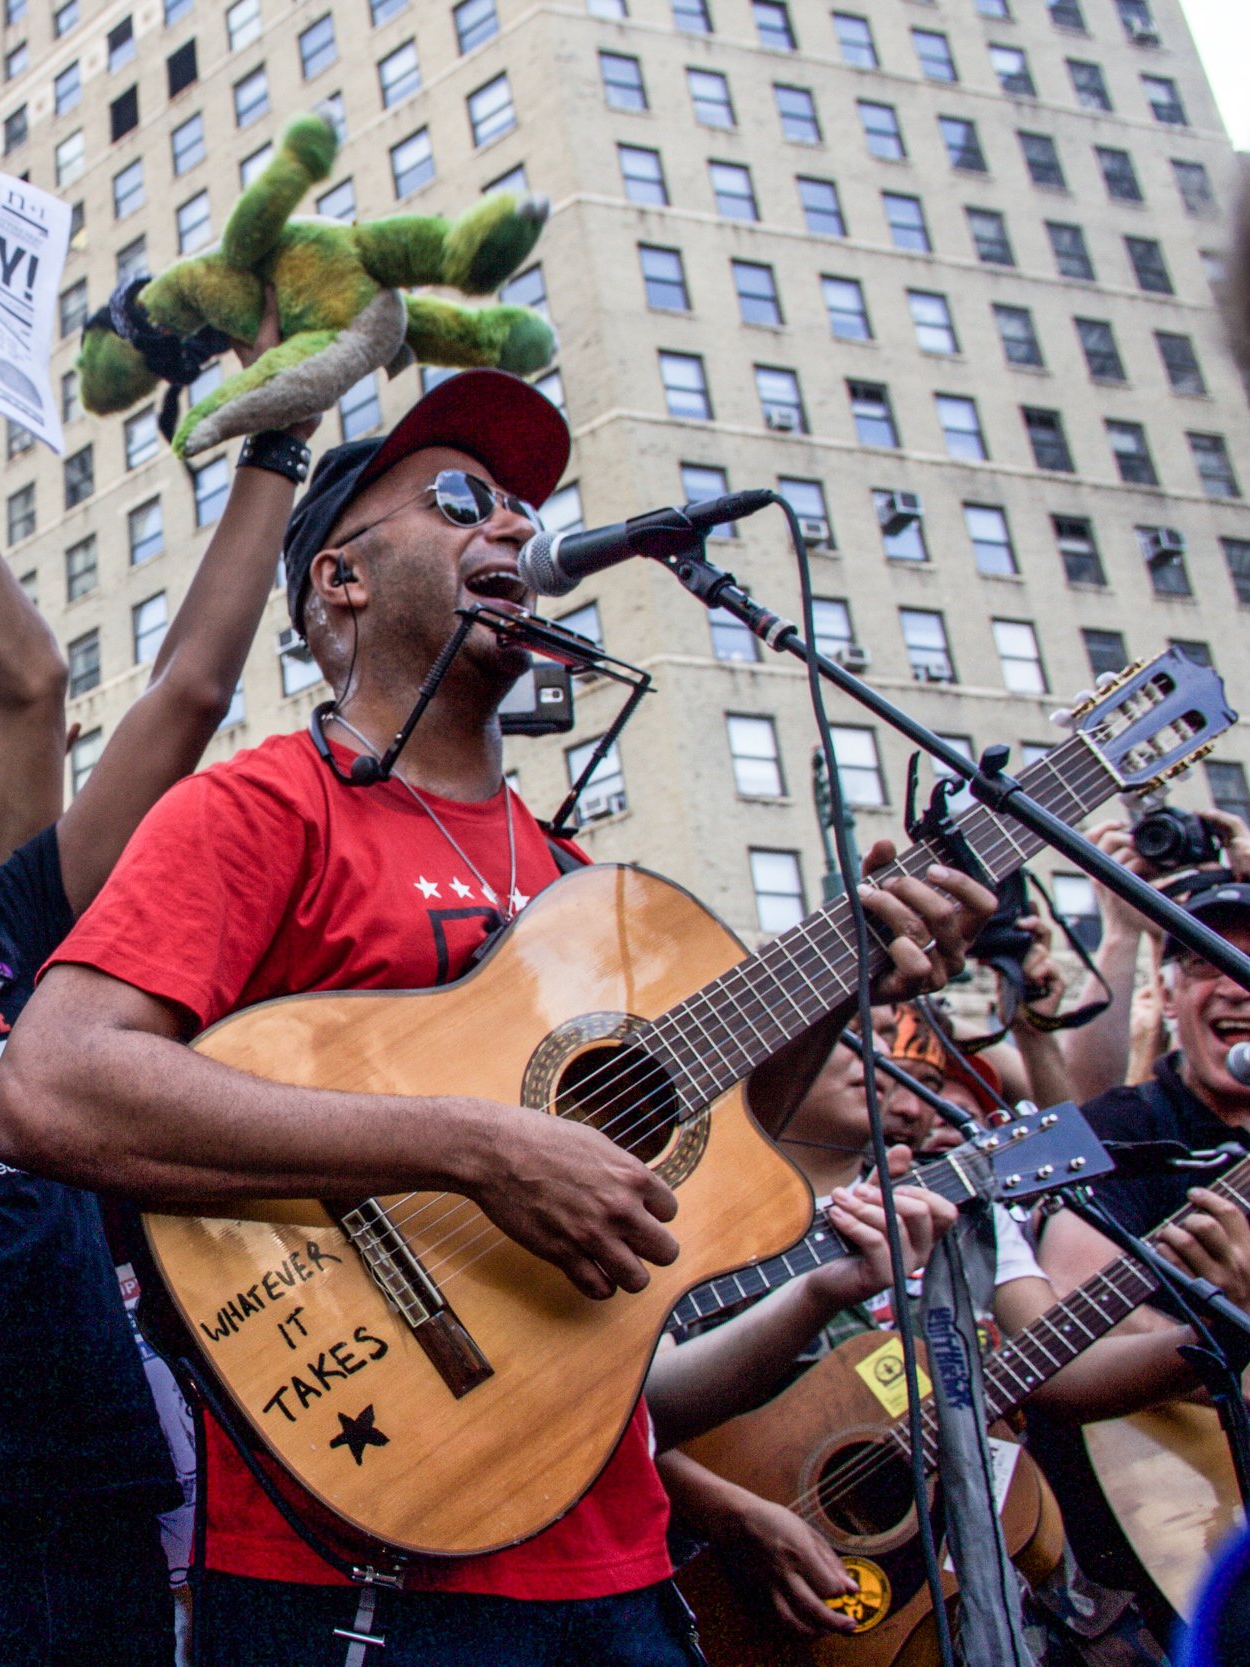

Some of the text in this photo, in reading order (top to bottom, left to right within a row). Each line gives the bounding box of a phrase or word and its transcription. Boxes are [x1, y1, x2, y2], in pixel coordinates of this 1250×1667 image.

[200, 1241, 343, 1343] WHATEVER
[277, 1306, 311, 1350] IT
[262, 1326, 390, 1422] TAKES
